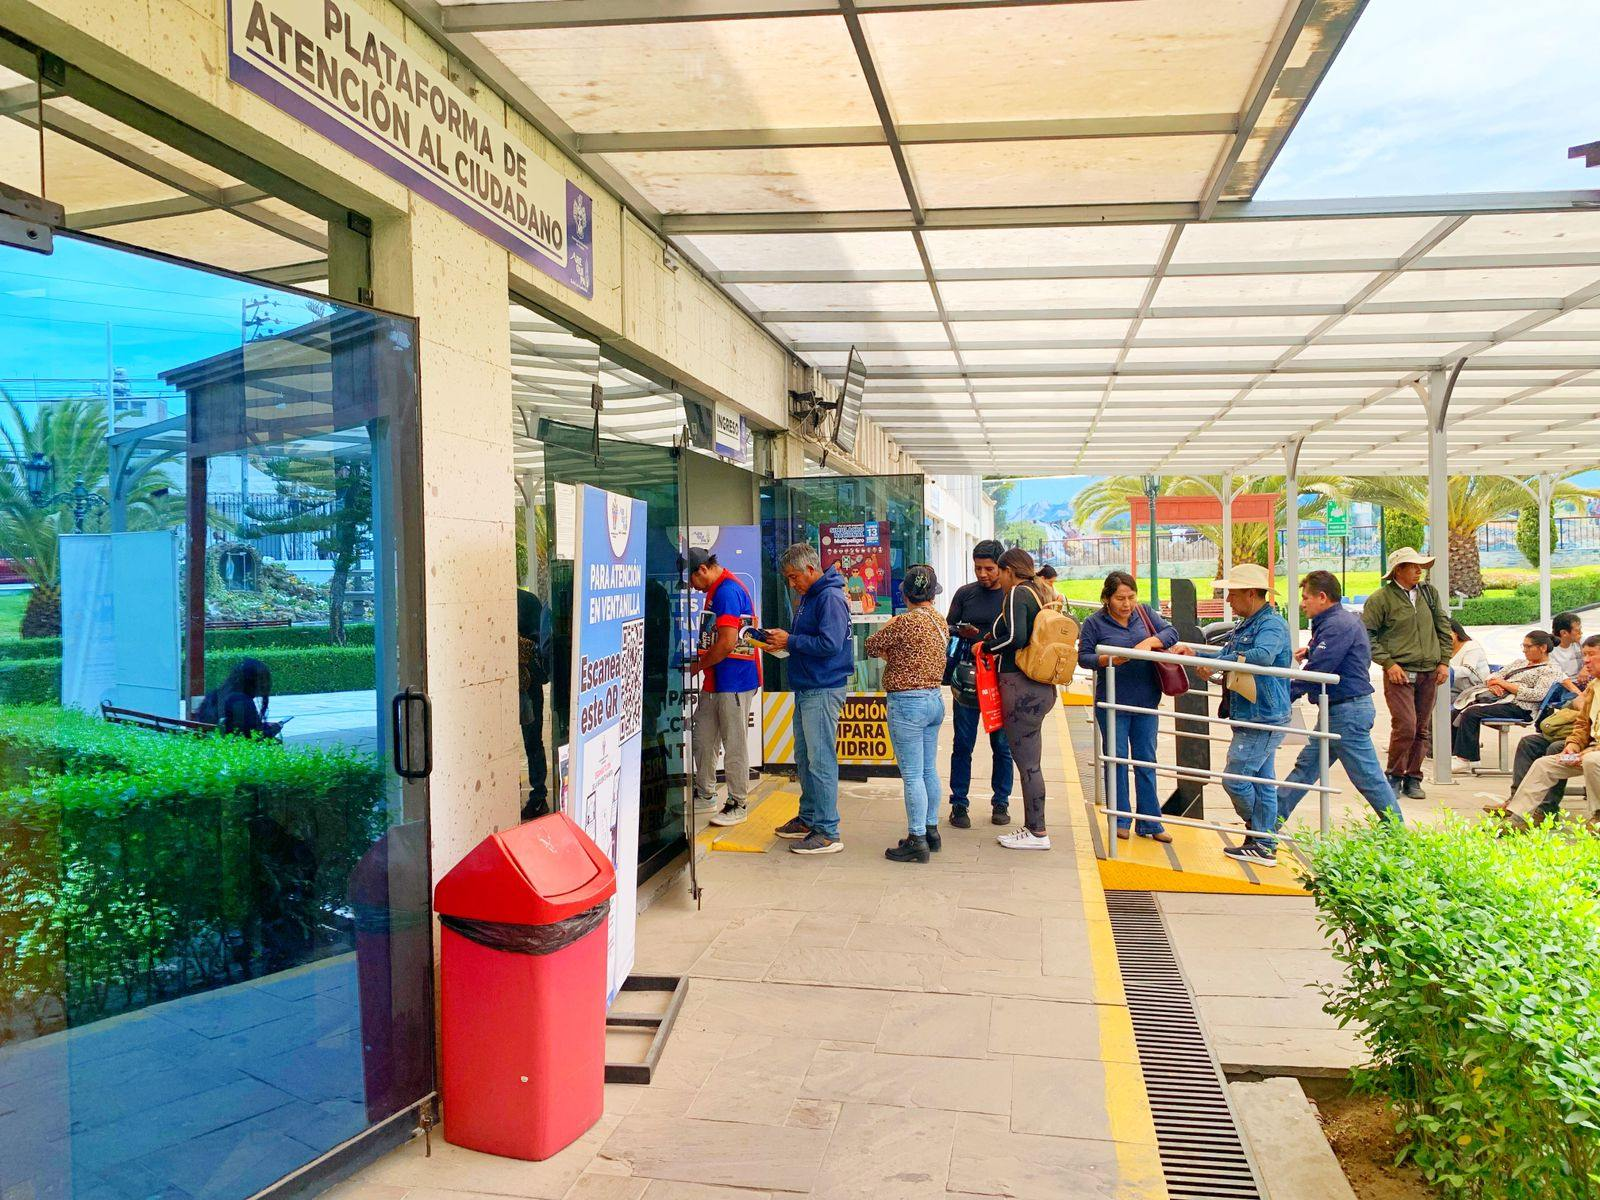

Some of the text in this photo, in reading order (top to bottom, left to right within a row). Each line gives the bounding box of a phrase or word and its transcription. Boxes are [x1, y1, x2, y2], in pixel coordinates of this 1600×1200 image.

[324, 0, 527, 189] PLATAFORMA DE
[245, 1, 563, 251] ATENCIÓN AL CIUDADANO
[716, 413, 739, 436] INGRESO
[867, 528, 878, 537] 13
[590, 564, 610, 591] PARA
[610, 558, 642, 589] ATENCIÓN
[589, 593, 641, 625] EN VENTANILLA
[580, 653, 621, 693] Escanea
[581, 684, 618, 735] este QR
